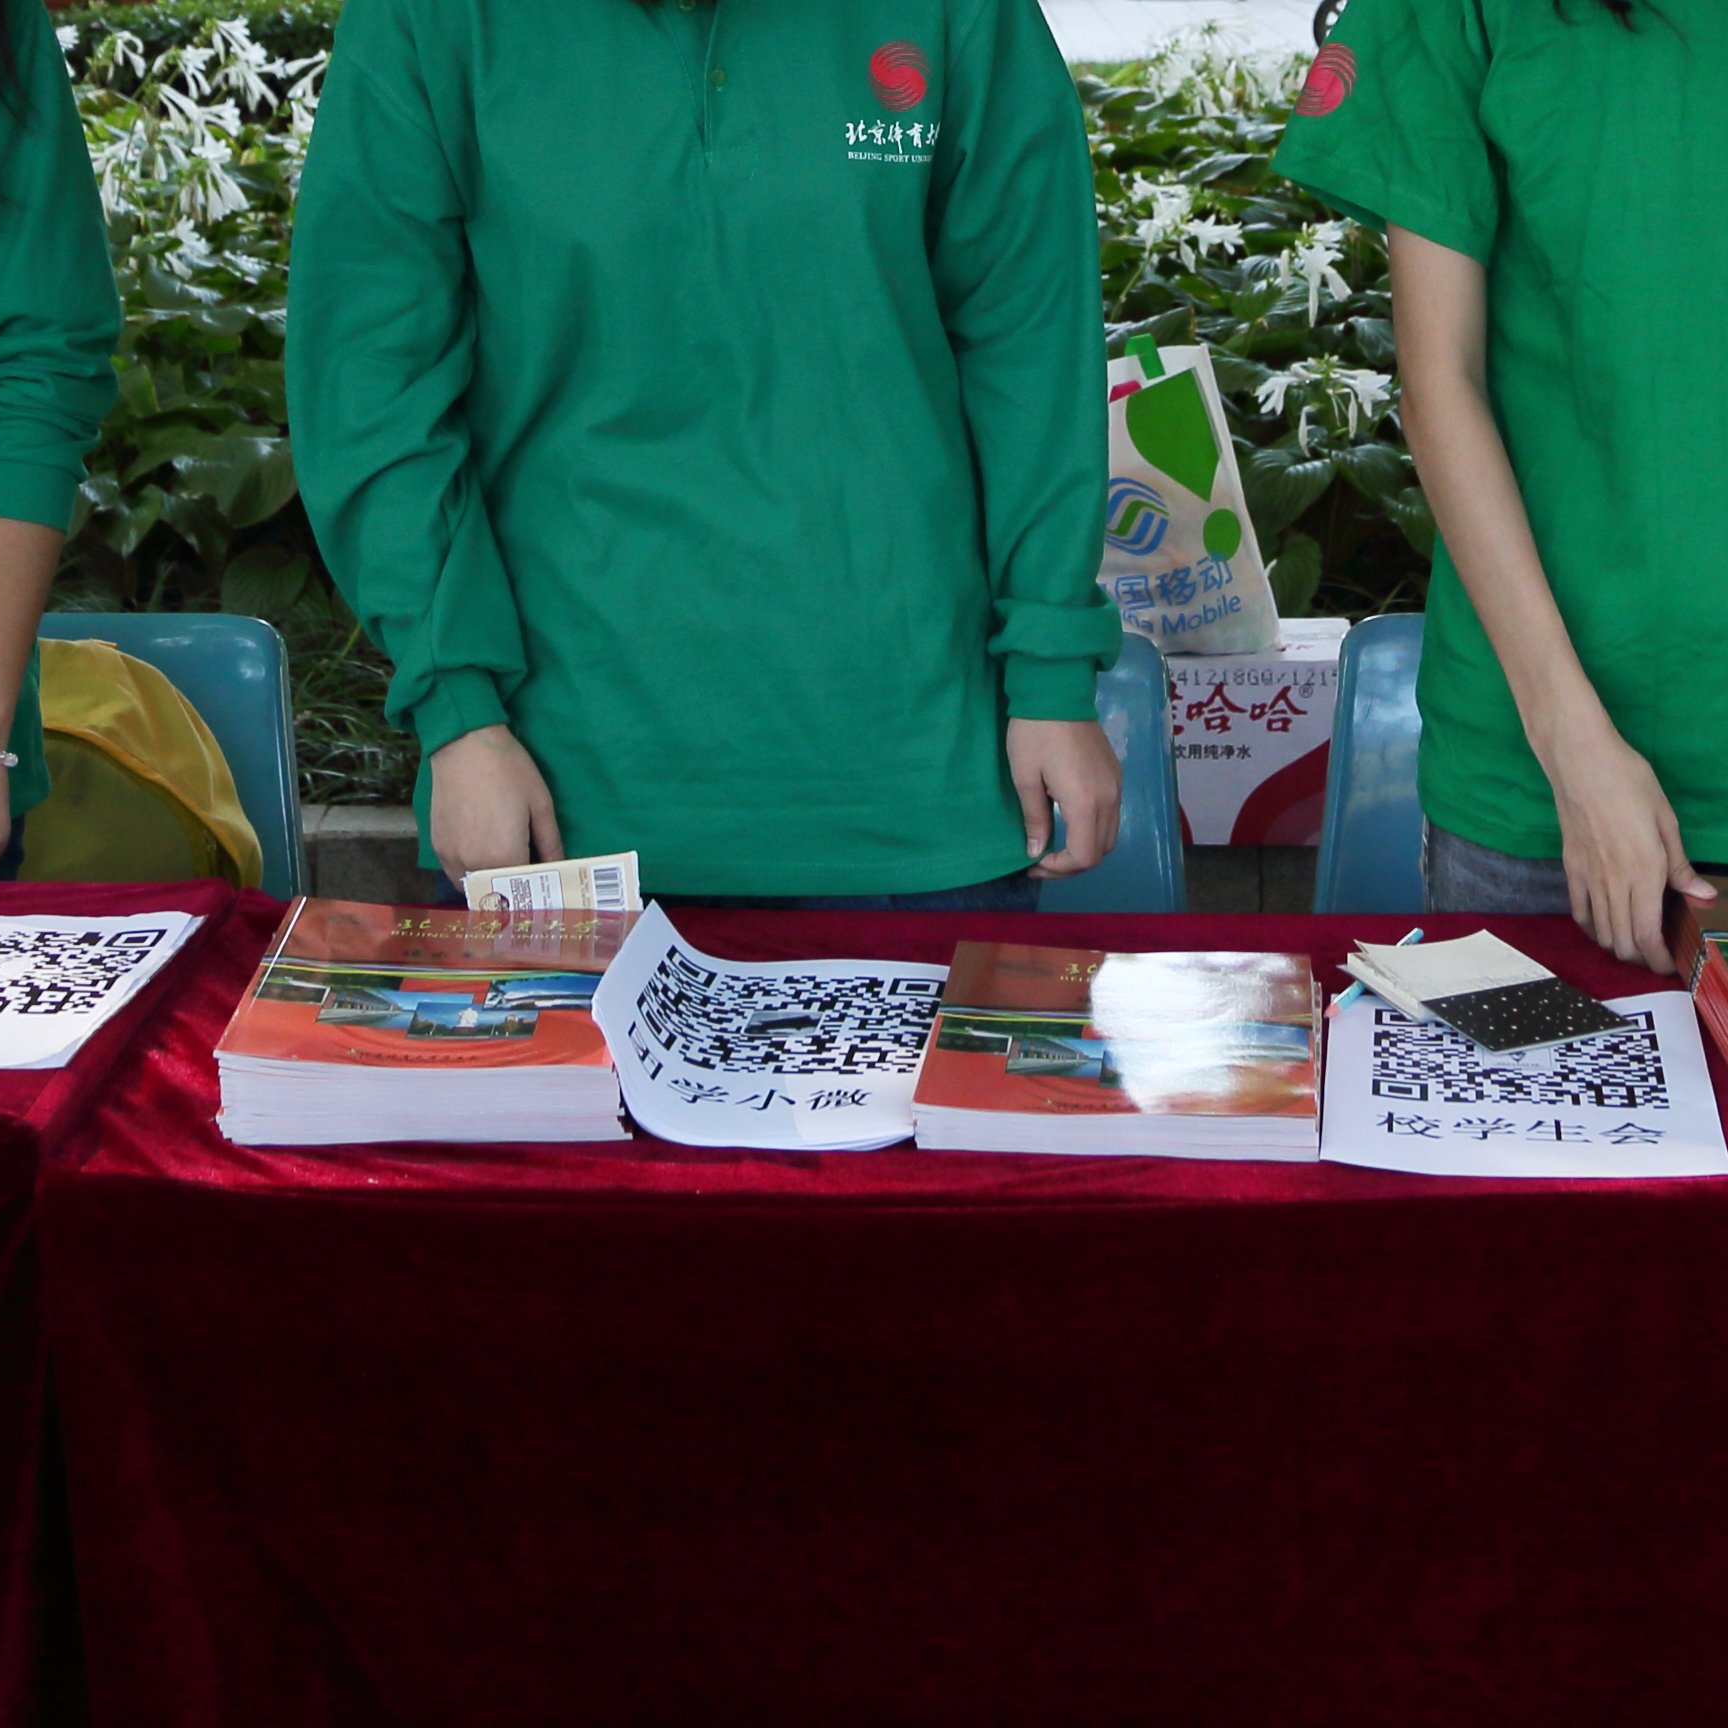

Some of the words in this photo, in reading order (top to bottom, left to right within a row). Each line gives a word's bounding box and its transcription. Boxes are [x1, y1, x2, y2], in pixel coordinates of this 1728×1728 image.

[847, 151, 883, 161] BEIJING
[883, 153, 910, 163] SPORT
[1101, 550, 1234, 612] 国移动
[1161, 594, 1243, 637] Mobile
[1376, 1111, 1667, 1146] 校学生会
